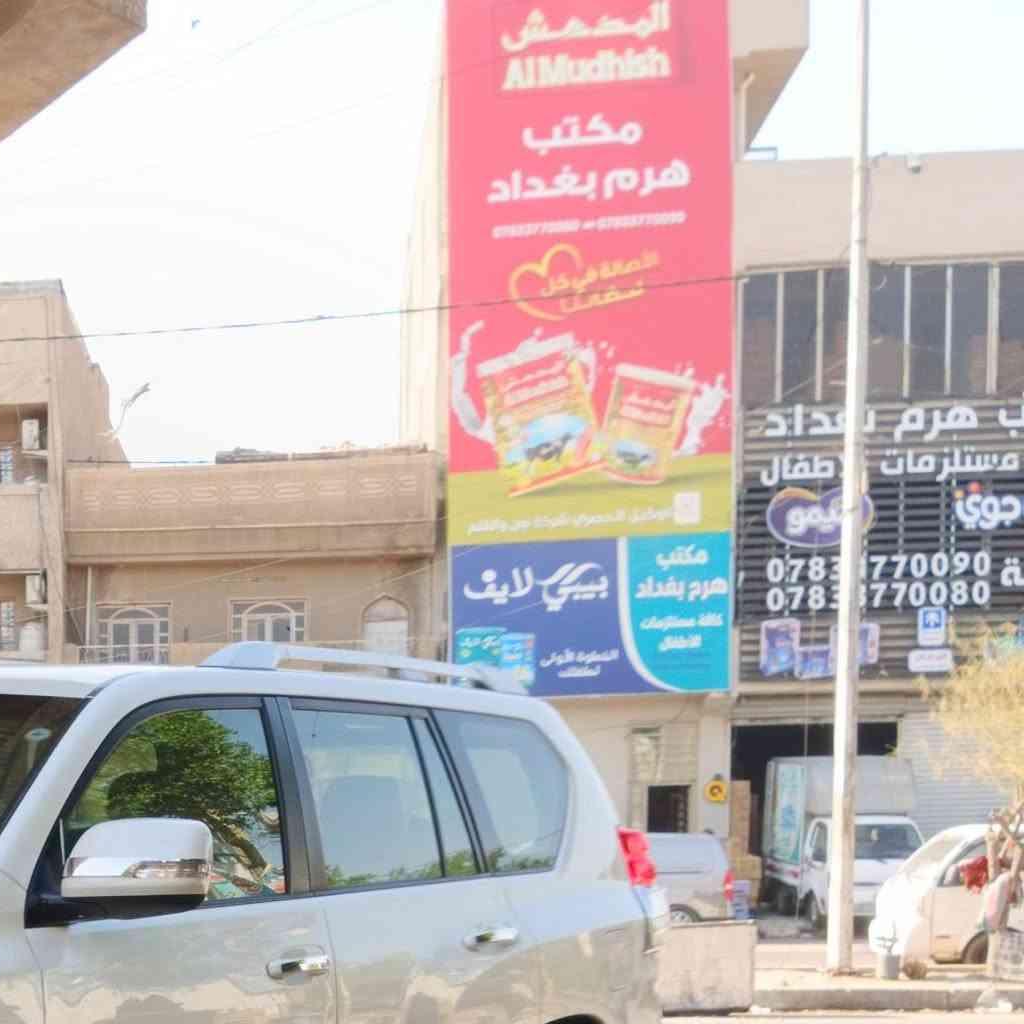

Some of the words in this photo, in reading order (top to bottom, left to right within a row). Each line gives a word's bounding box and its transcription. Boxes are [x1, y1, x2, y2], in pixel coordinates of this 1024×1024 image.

[522, 113, 642, 156] مكتب
[487, 164, 597, 203] بغداد
[604, 158, 691, 200] هرم
[894, 405, 977, 443] هرم
[880, 445, 1020, 482] مستلزمات
[656, 544, 708, 572] مكتب
[766, 551, 992, 584] 0783770090
[463, 566, 534, 605] لايف
[634, 576, 685, 601] بغداد
[688, 577, 728, 602] هرم
[766, 580, 991, 611] 0783770080
